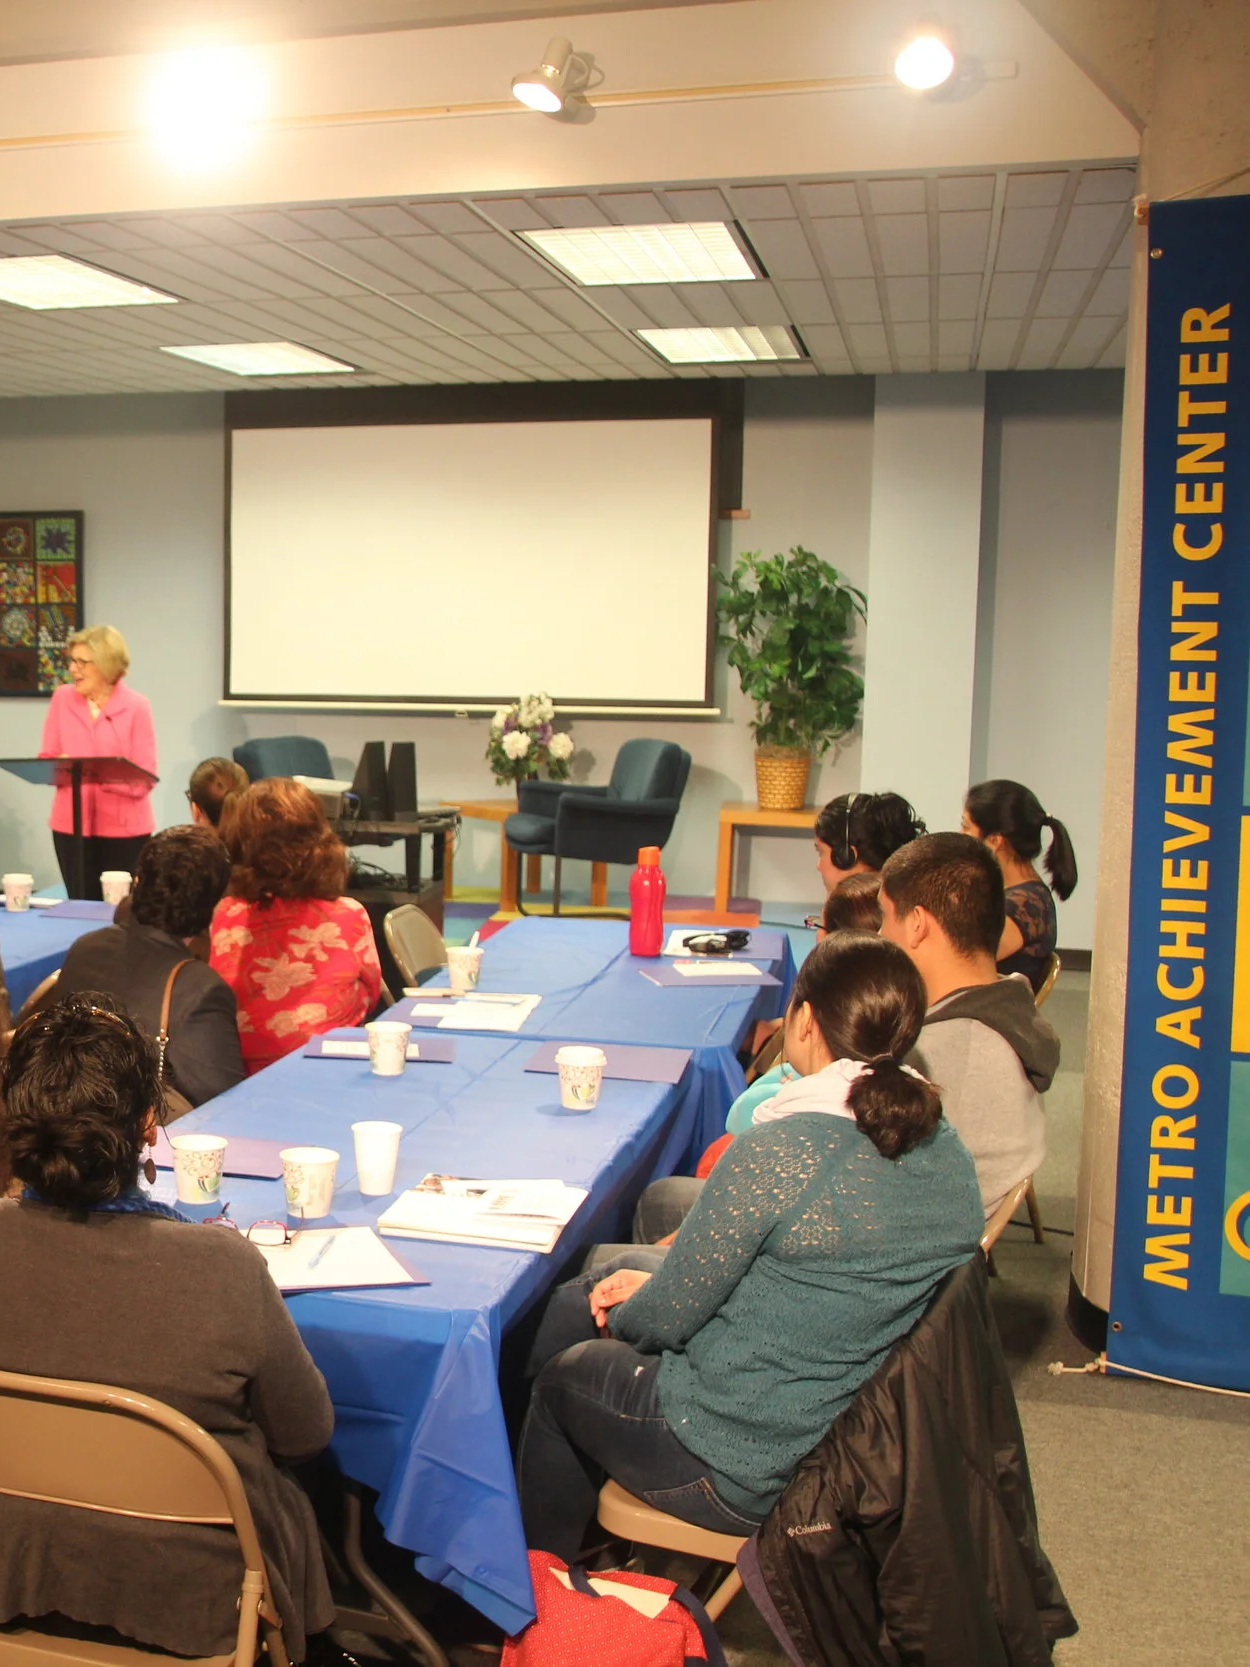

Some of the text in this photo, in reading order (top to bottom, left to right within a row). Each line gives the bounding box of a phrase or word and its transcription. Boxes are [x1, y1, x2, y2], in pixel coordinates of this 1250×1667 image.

[1143, 303, 1231, 1291] METRO ACHIEVEMENT CENTER
[795, 1521, 832, 1536] Columbia
